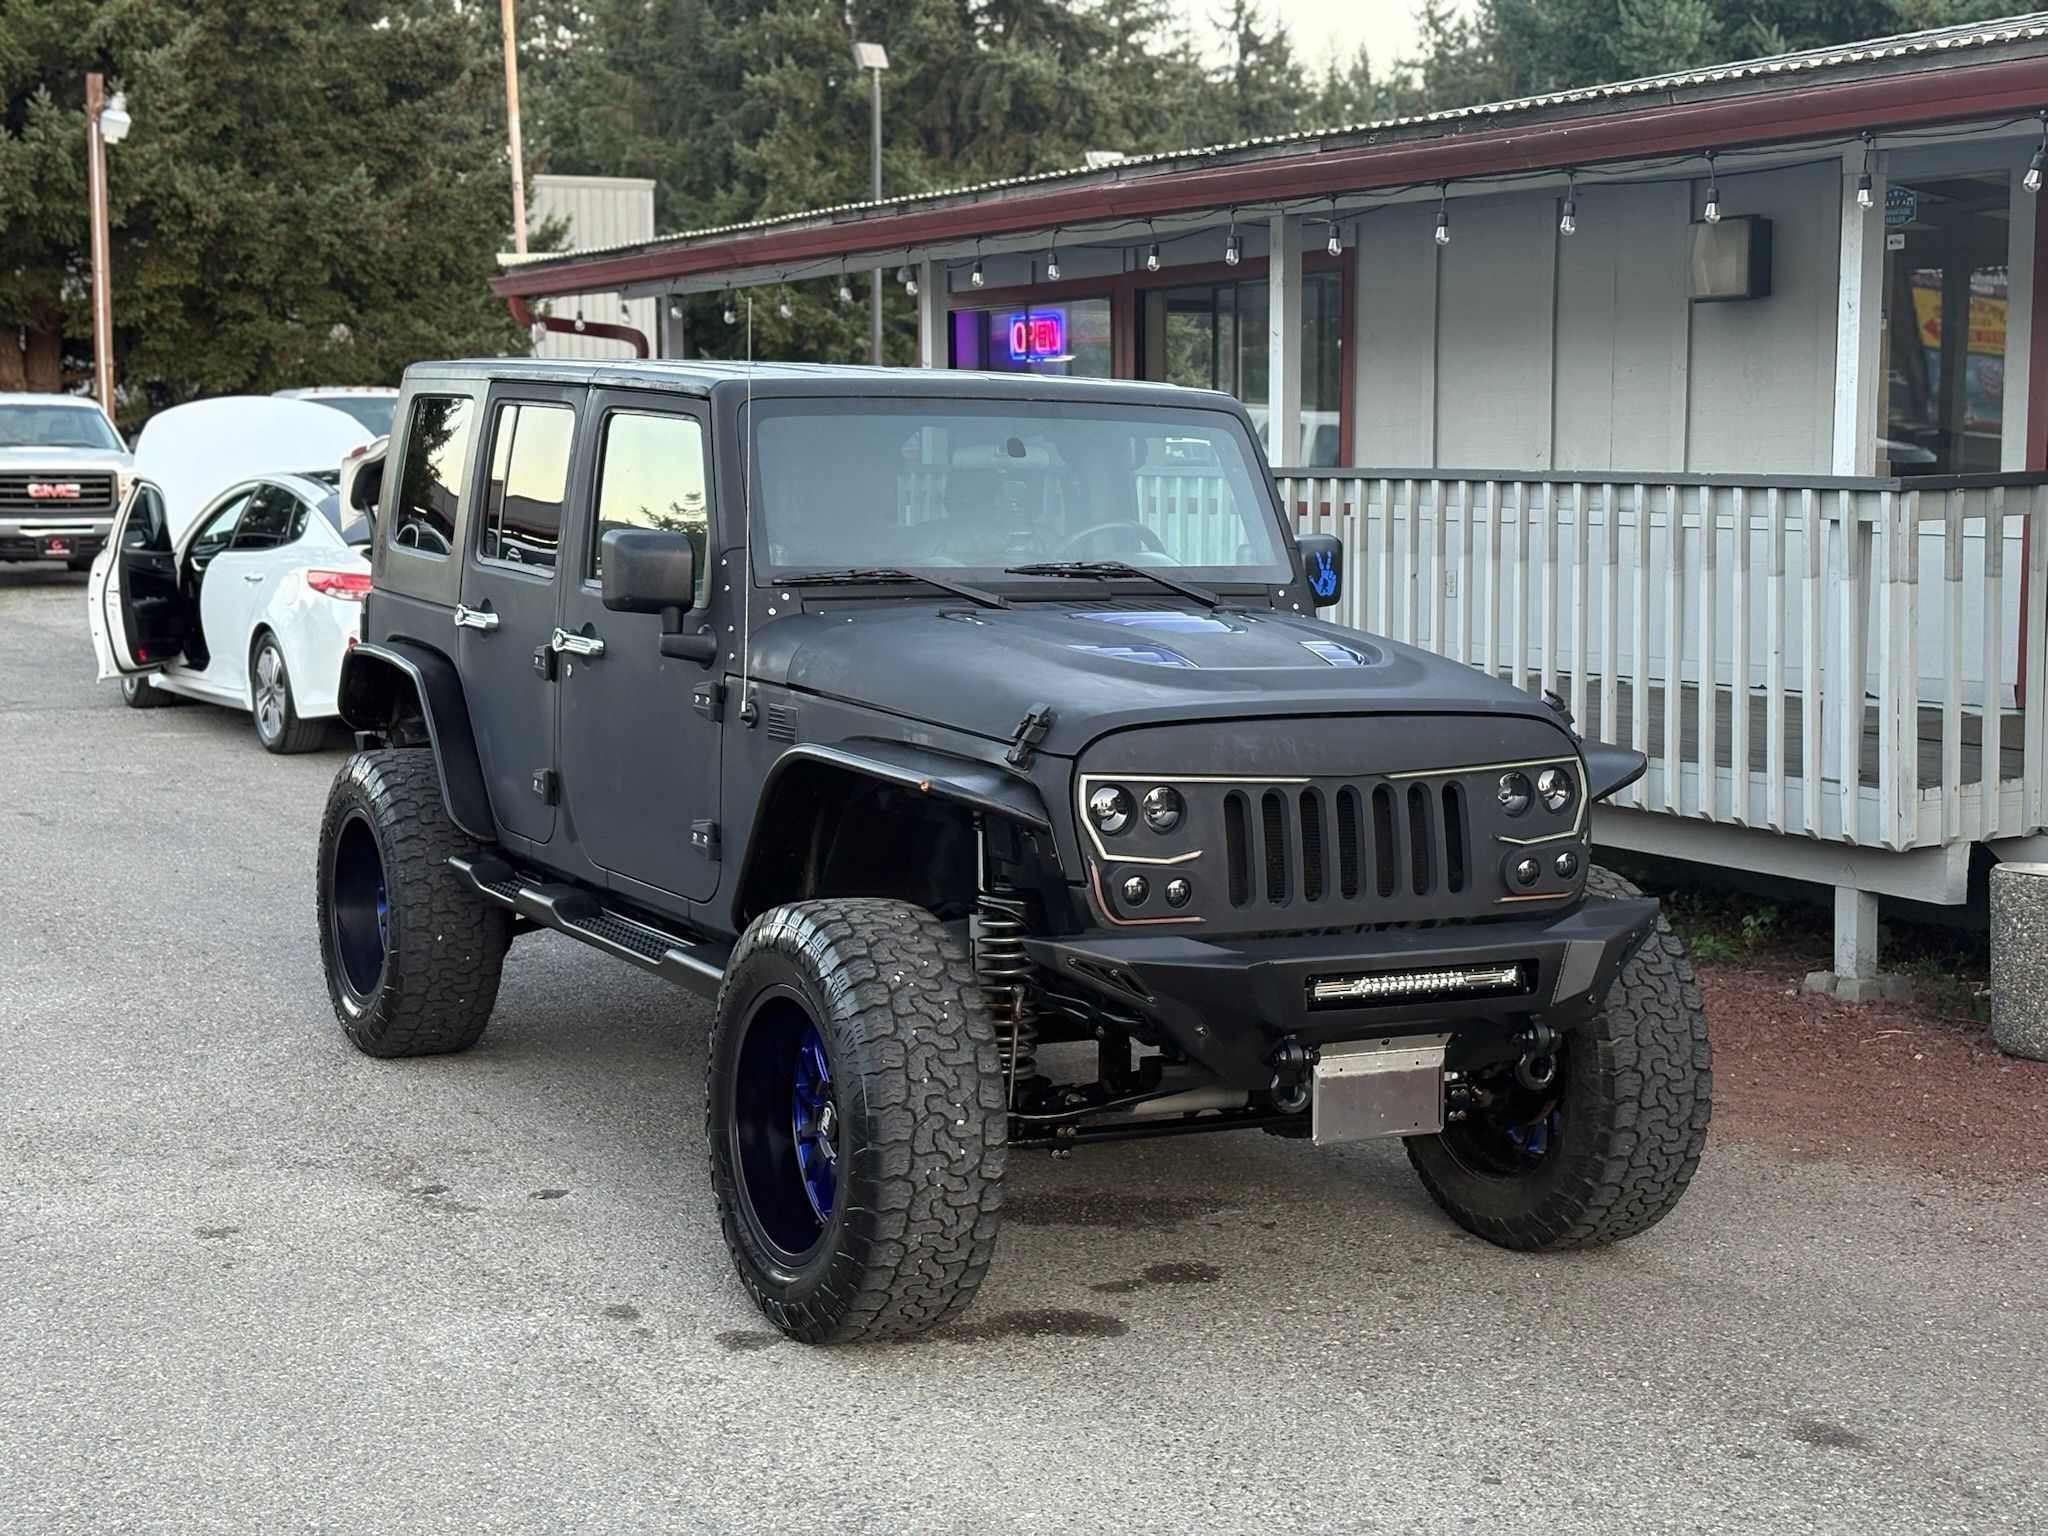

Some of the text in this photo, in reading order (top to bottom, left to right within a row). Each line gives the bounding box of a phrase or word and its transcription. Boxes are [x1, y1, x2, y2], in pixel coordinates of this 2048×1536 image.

[1885, 197, 1914, 207] ARFAX
[1013, 320, 1061, 354] OPEN
[27, 484, 81, 498] GMC
